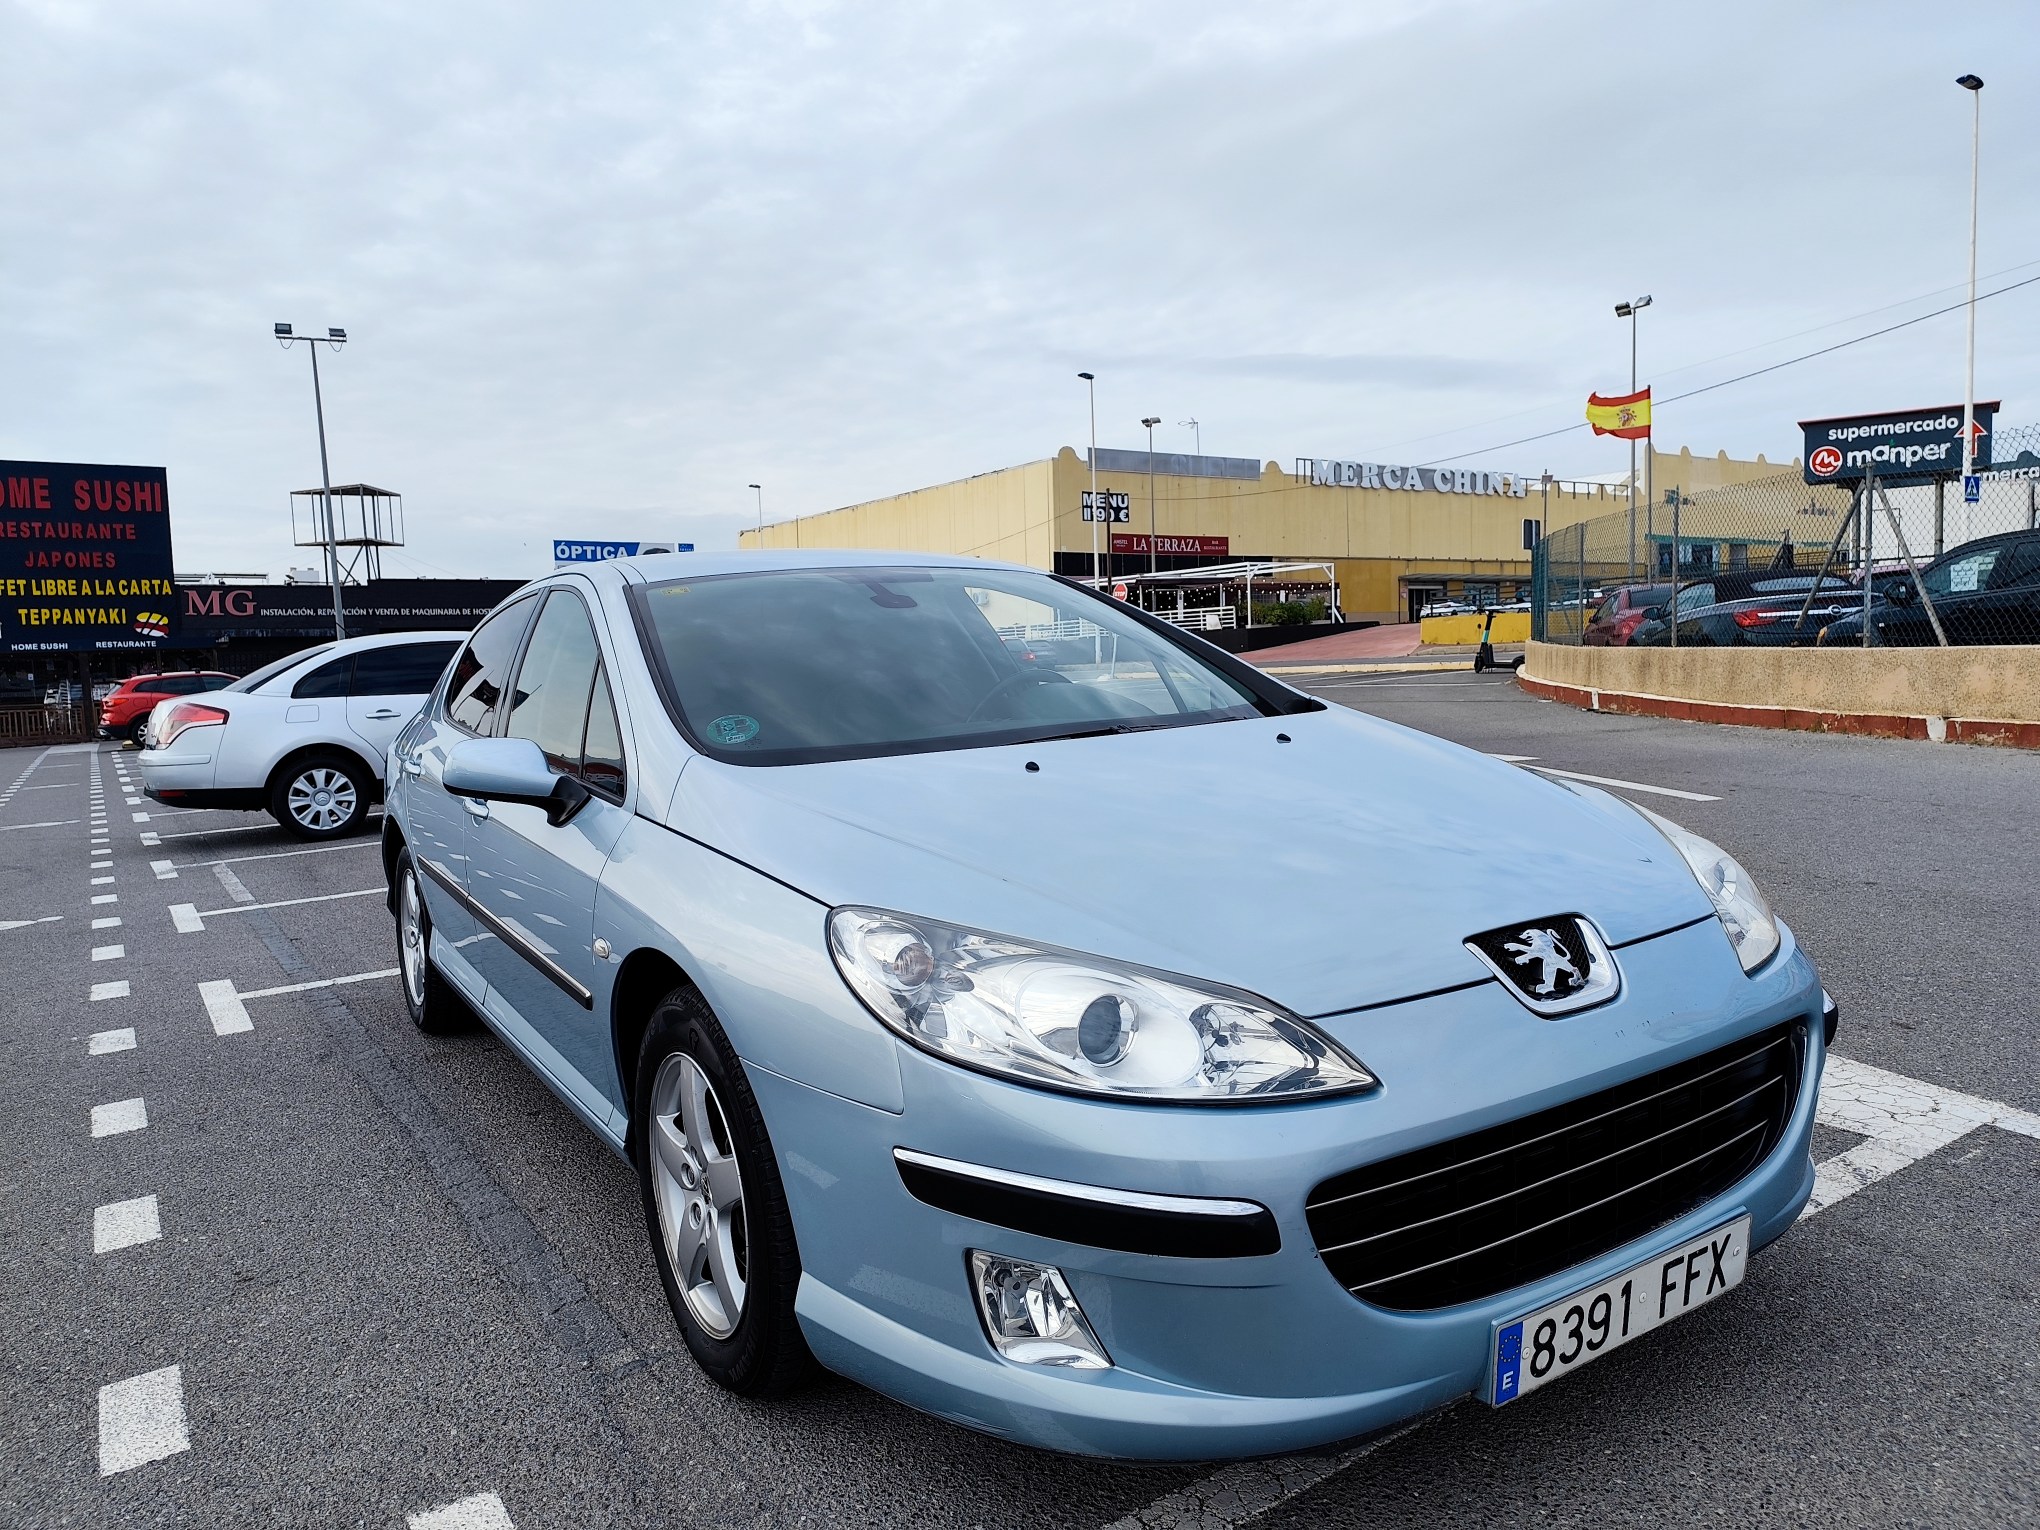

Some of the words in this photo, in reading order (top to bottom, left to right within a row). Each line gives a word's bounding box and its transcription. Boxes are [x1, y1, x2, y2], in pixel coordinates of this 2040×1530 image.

[1827, 414, 1959, 442] supermercado
[1846, 441, 1953, 468] manper
[1311, 459, 1425, 491] MERCA
[1433, 468, 1526, 498] CHINA
[74, 479, 162, 512] SUSHI
[556, 542, 628, 560] ÓPTICA
[1133, 537, 1148, 551] LA
[1149, 537, 1201, 552] TERRAZA
[25, 551, 117, 568] JAPONES
[32, 579, 78, 596] LIBRE
[82, 579, 92, 596] A
[95, 579, 116, 596] LA
[119, 579, 172, 595] CARTA
[184, 589, 257, 616] MG
[260, 606, 316, 617] INSTALACIÓN,
[317, 606, 367, 616] REPAACIÓN
[368, 608, 374, 616] Y
[375, 608, 399, 616] VENTA
[401, 608, 411, 616] DE
[412, 608, 461, 617] MAQUINARIA
[462, 608, 472, 616] DE
[18, 608, 127, 625] TEPPANYAKI
[11, 643, 39, 651] HOME
[40, 642, 69, 650] SUSHI
[95, 640, 157, 648] RESTAURANTE
[1529, 1279, 1633, 1378] 8391
[1659, 1233, 1732, 1319] FFX
[1502, 1370, 1514, 1390] E
